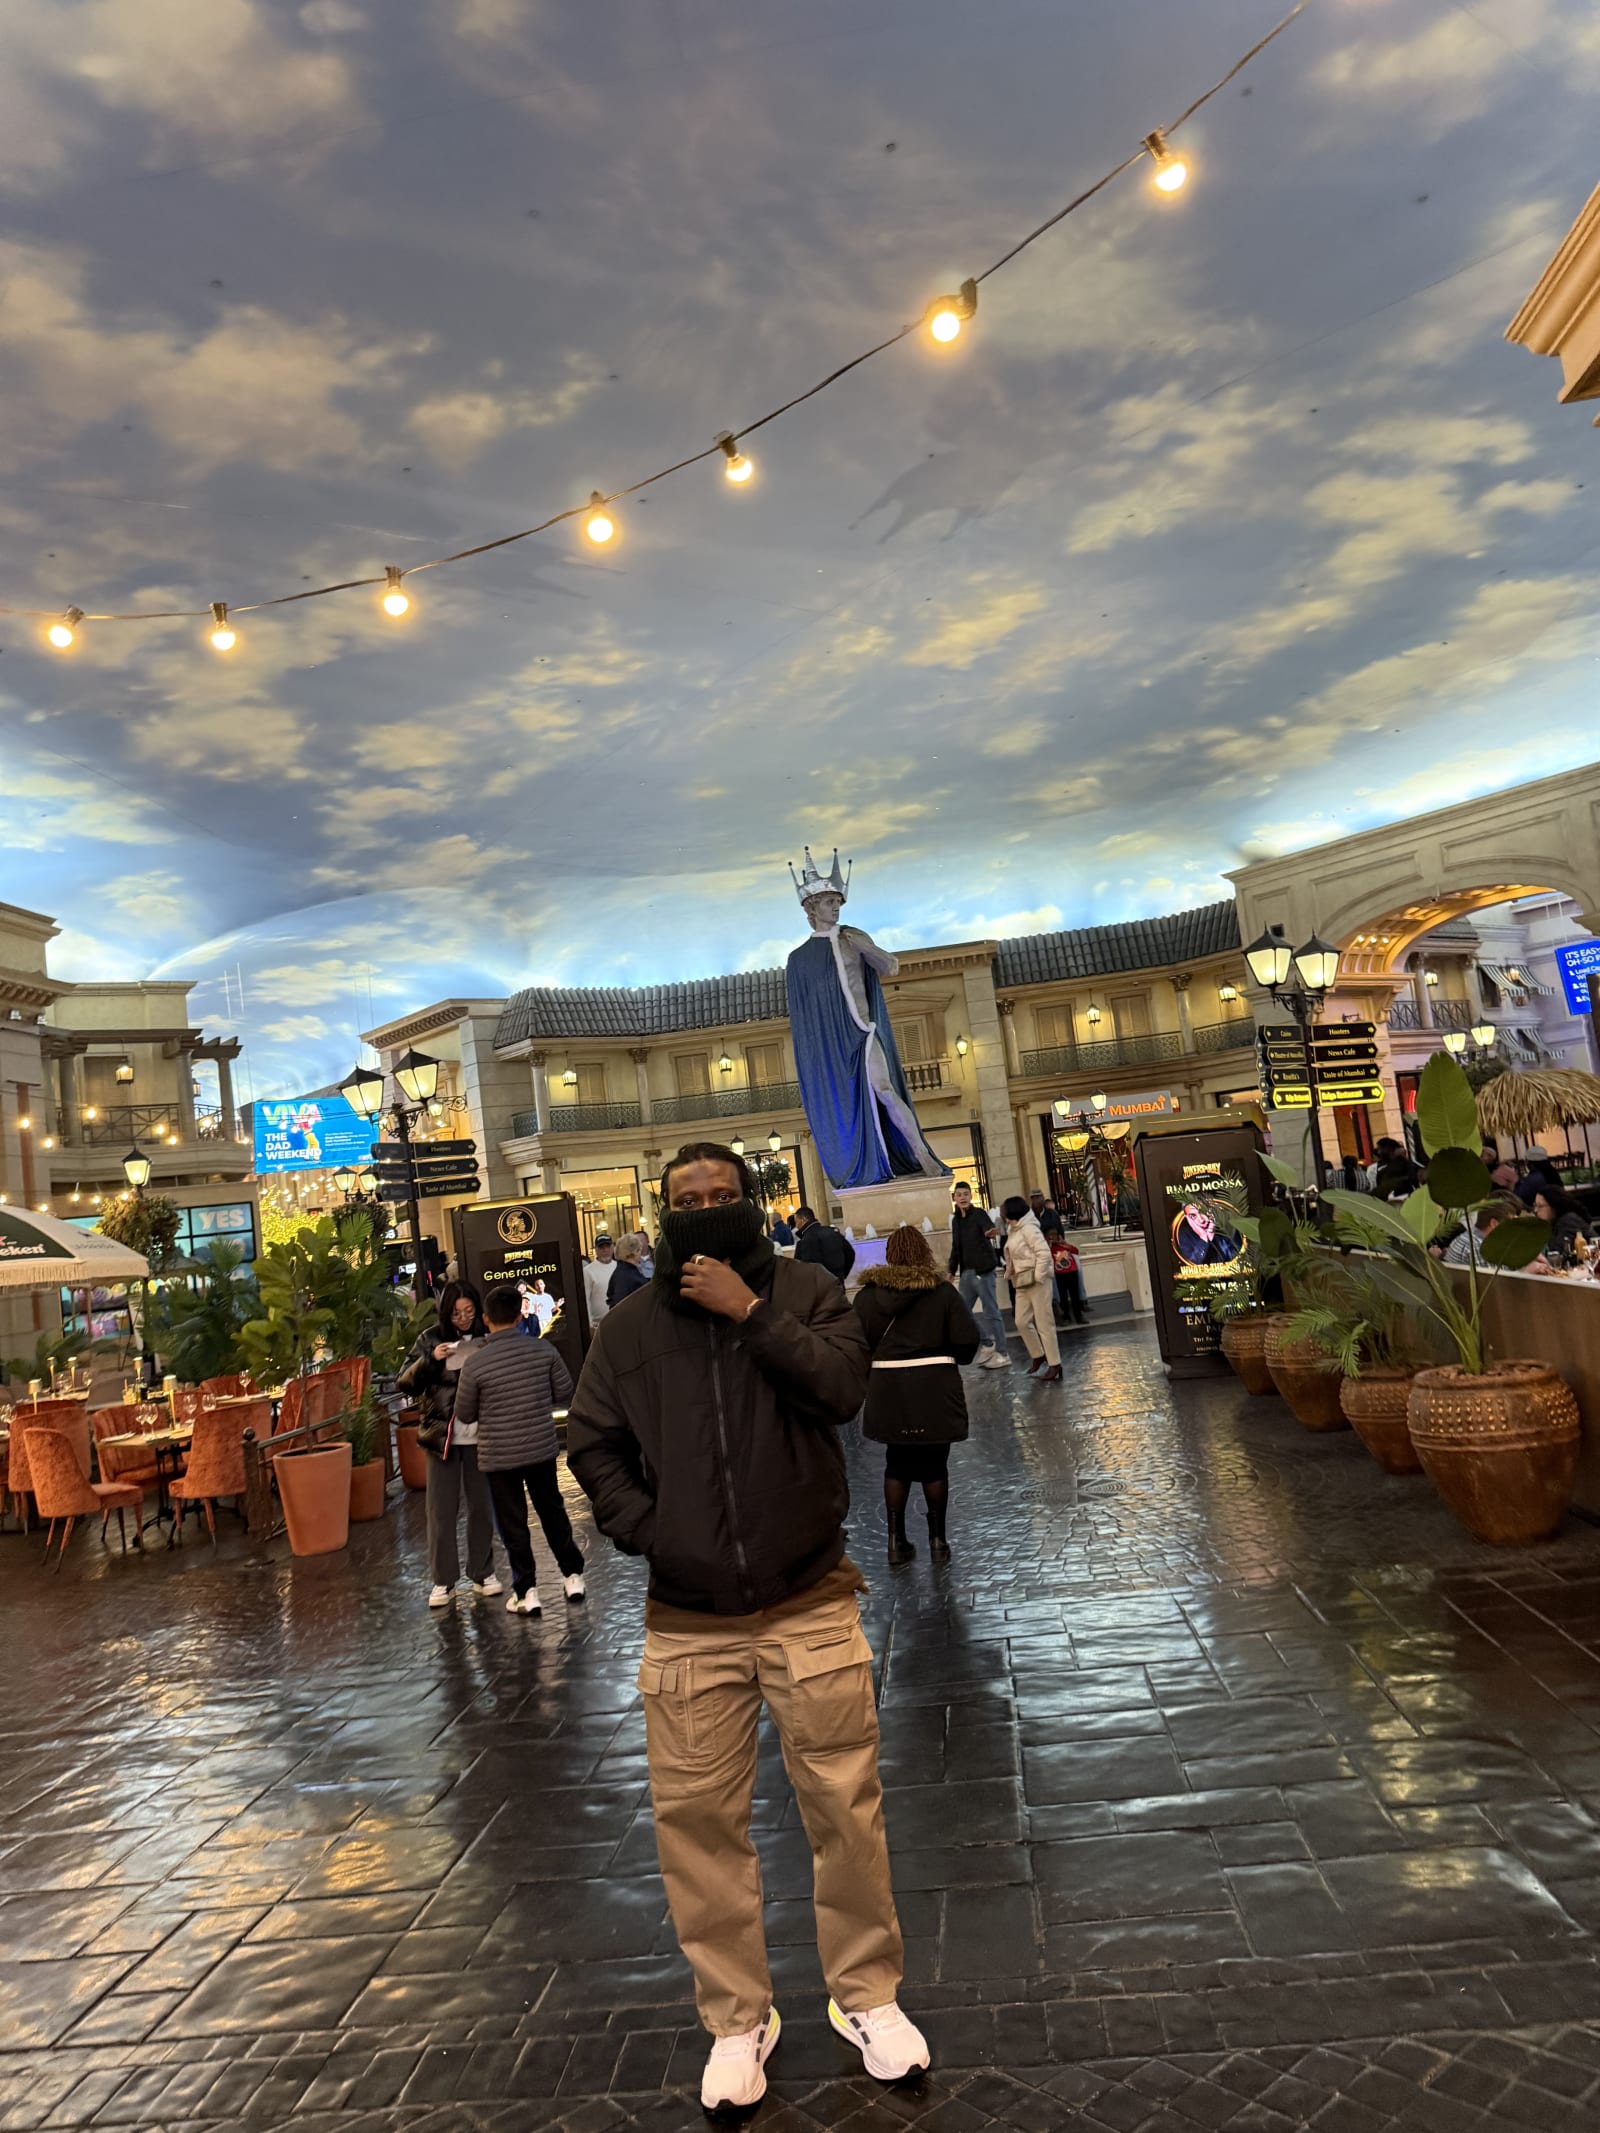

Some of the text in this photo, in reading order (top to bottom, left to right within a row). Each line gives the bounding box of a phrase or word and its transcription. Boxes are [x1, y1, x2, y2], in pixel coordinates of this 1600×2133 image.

[264, 1132, 287, 1142] THE
[265, 1141, 291, 1151] DAD
[265, 1148, 322, 1160] WEEKEND
[198, 1208, 245, 1230] YES
[483, 1263, 557, 1281] Generations
